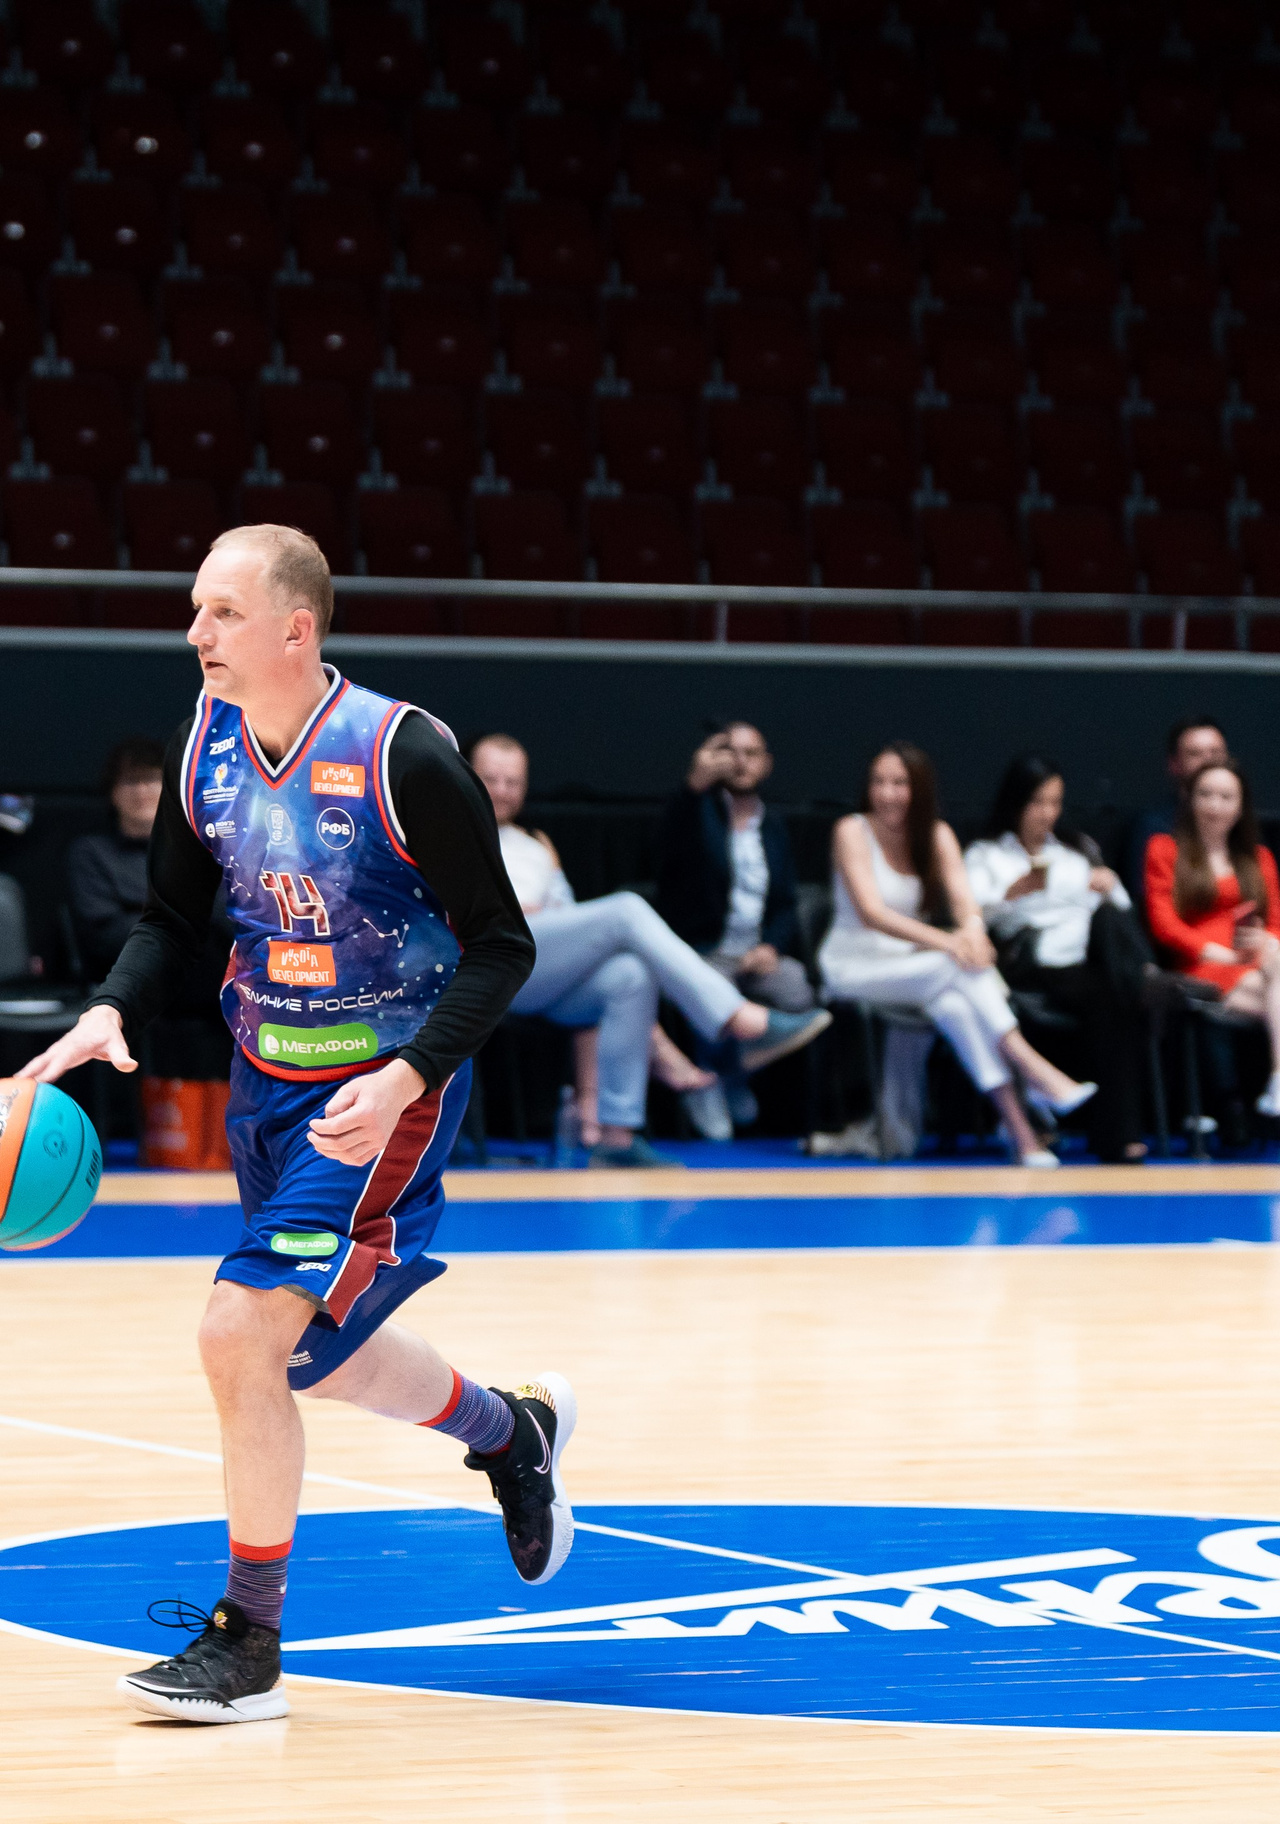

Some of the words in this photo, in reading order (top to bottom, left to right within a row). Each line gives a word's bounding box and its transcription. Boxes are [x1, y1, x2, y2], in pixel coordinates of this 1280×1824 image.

[209, 736, 236, 755] ZEDO
[314, 781, 361, 795] DEVELOPMENT
[321, 821, 351, 836] РФБ
[258, 870, 331, 936] 14
[271, 968, 331, 983] DEVELOPMENT
[308, 988, 404, 1012] РОССИИ
